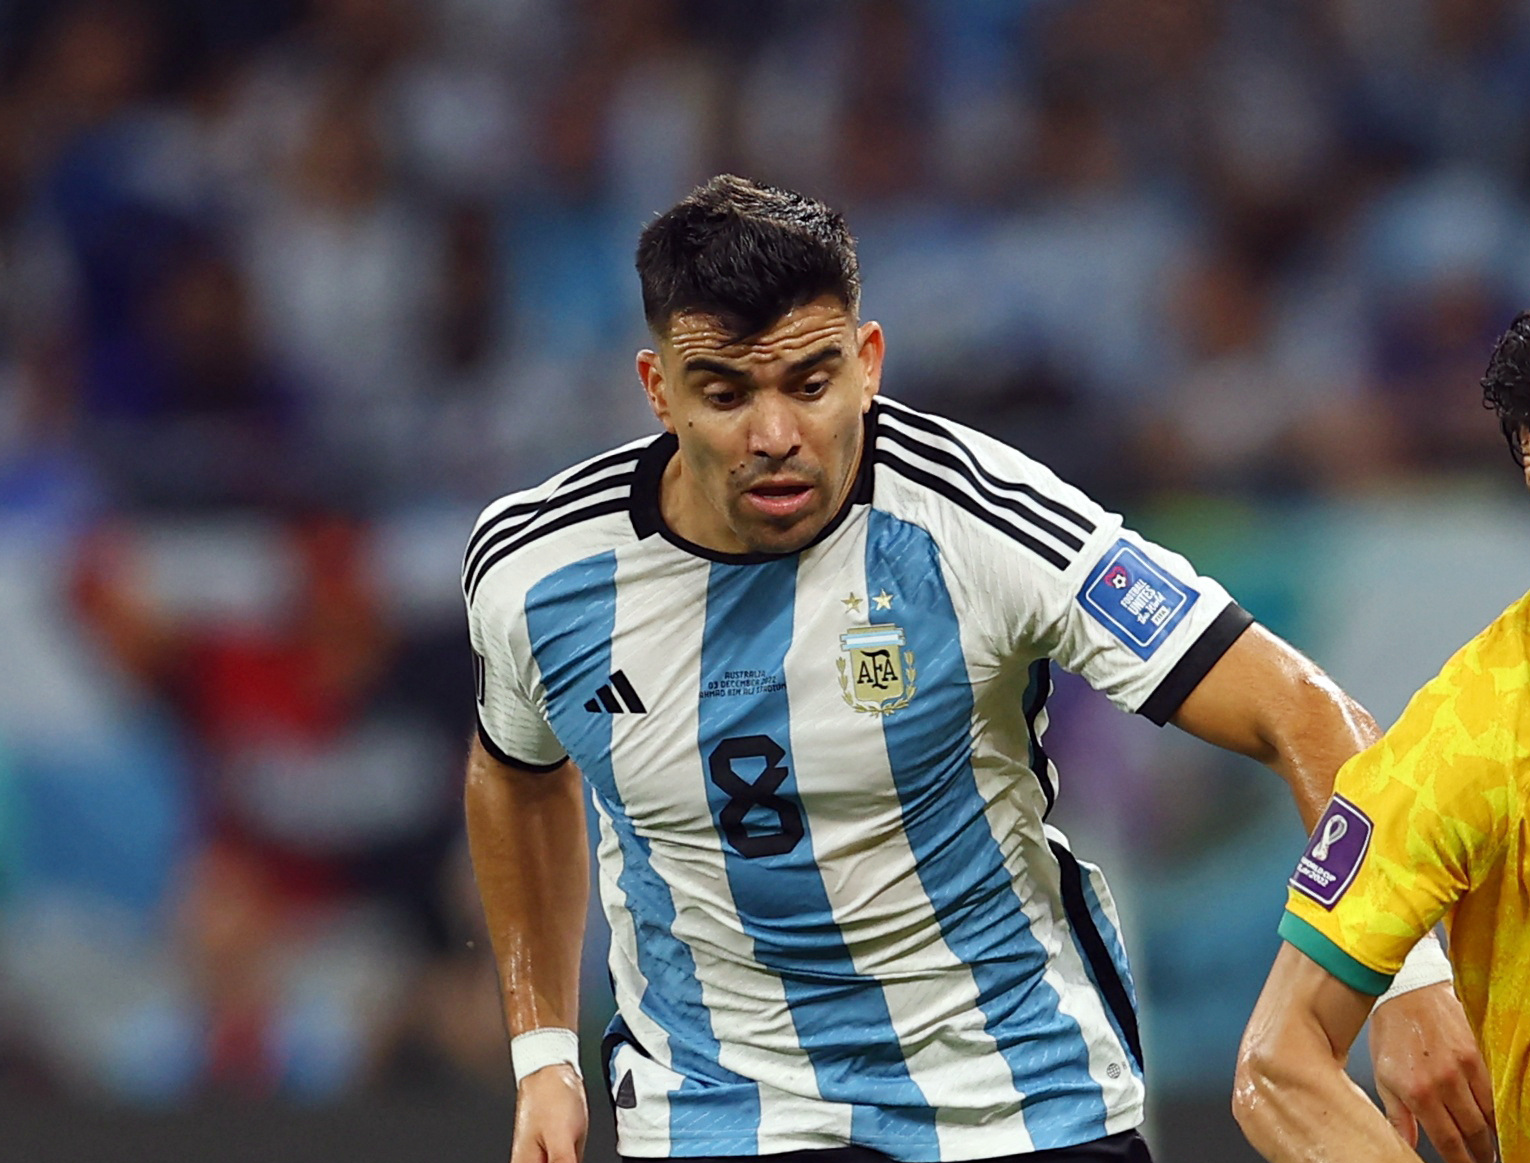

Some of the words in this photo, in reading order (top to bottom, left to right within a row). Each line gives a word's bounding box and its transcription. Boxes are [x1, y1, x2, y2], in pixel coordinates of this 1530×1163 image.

[1127, 585, 1156, 616] UNITES
[725, 670, 766, 680] AUSTRALIA
[857, 649, 899, 690] AFA
[700, 689, 726, 699] AHMAD
[708, 680, 719, 690] 03
[720, 679, 760, 688] DECEMBER
[709, 734, 805, 860] 8
